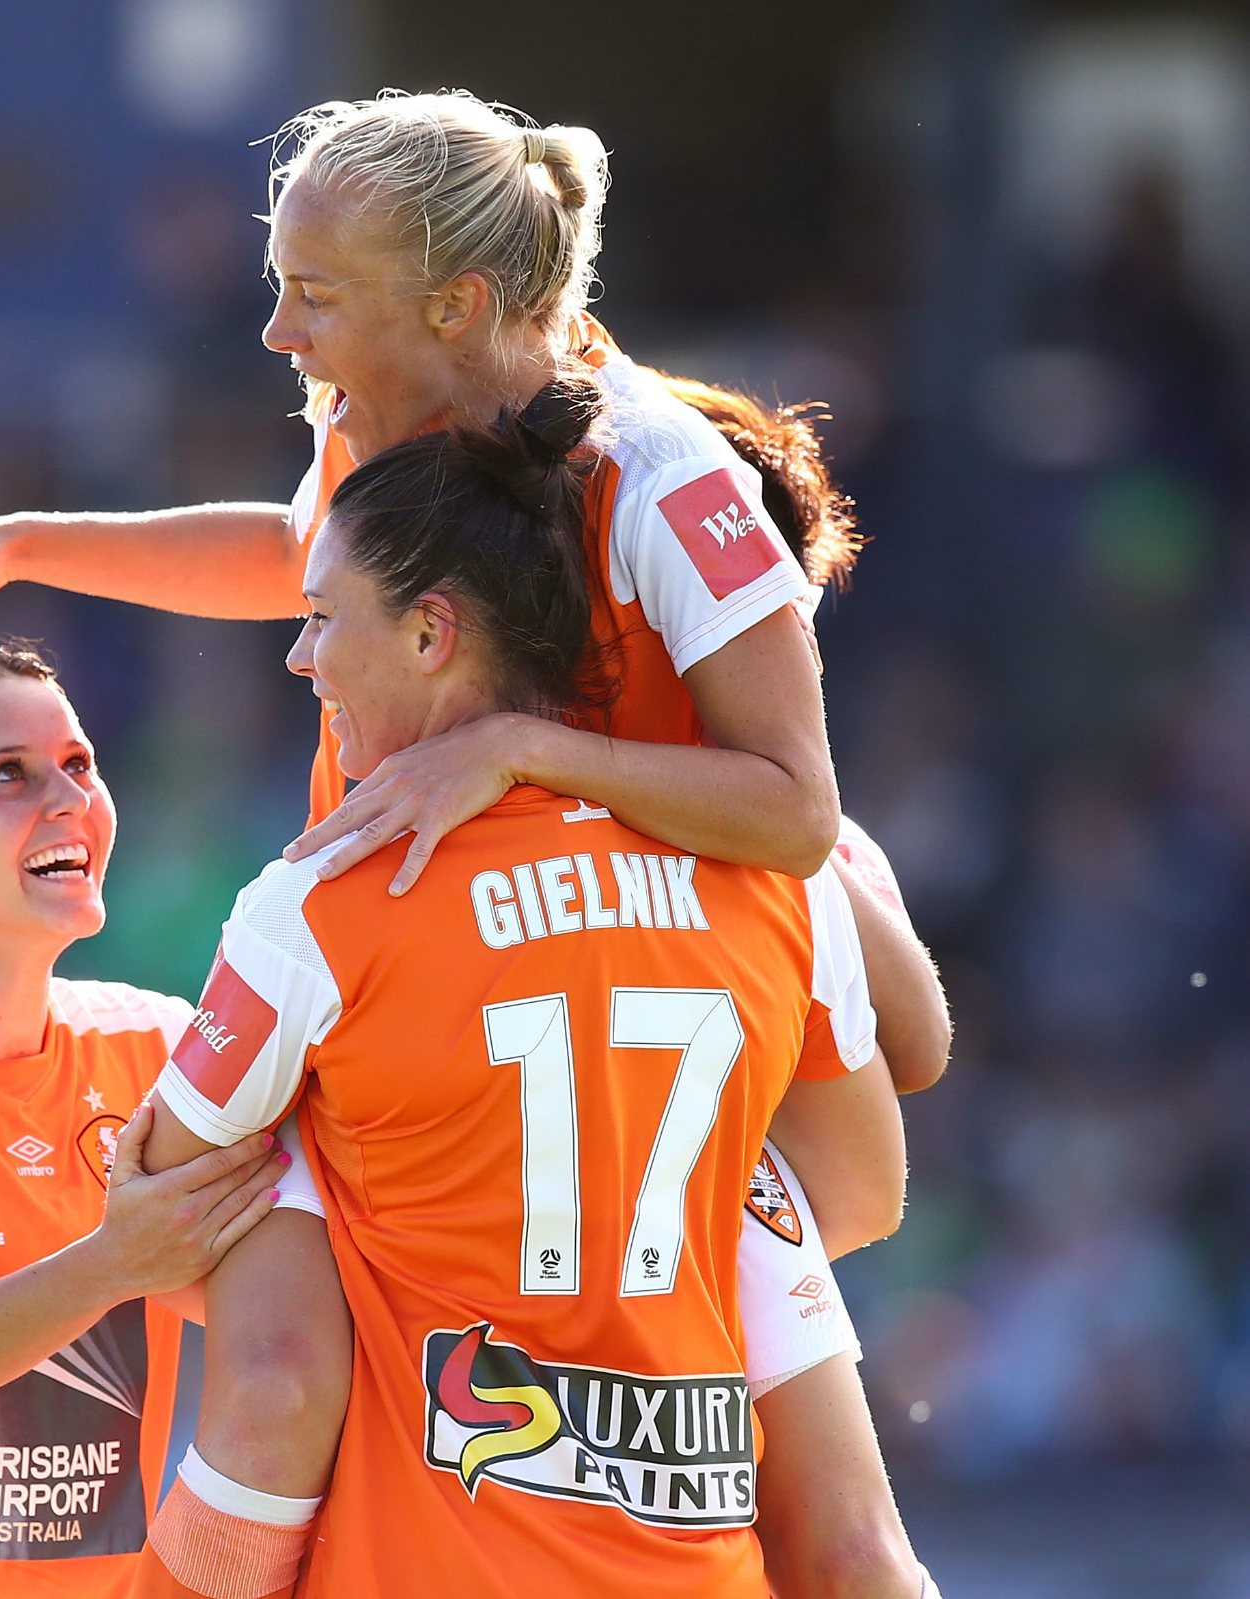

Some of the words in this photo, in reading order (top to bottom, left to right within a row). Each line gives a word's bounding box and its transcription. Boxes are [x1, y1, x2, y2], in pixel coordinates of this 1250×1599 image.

[470, 851, 711, 950] GIELNIK
[192, 1006, 238, 1054] tfield
[16, 1164, 55, 1177] umbro
[482, 986, 746, 1297] 17
[799, 1300, 832, 1319] umbro
[557, 1376, 749, 1457] LUXURY
[575, 1446, 750, 1511] PAINTS
